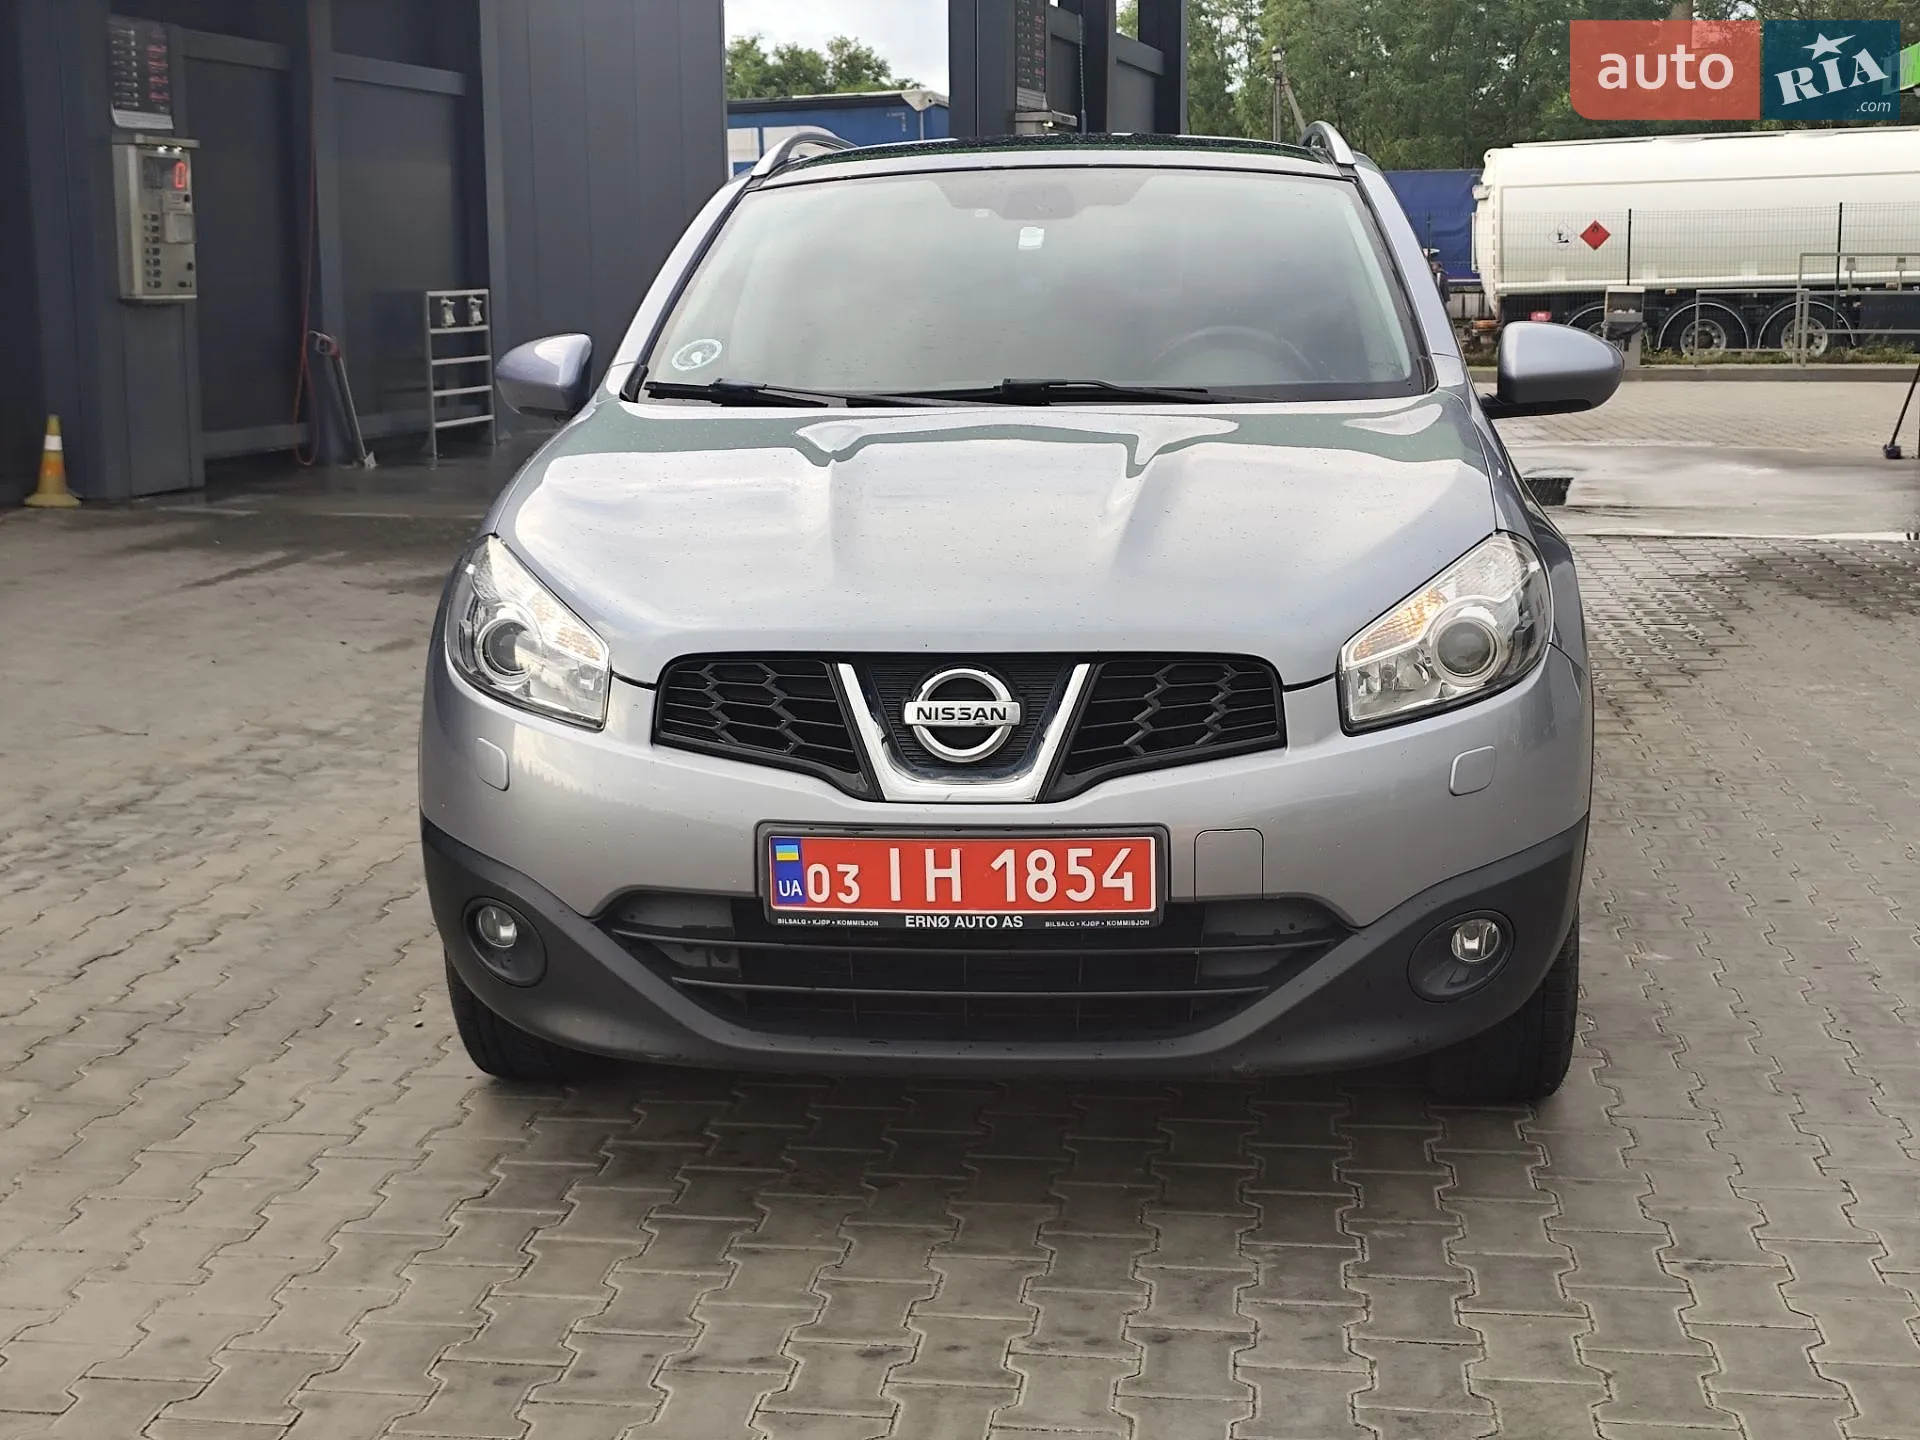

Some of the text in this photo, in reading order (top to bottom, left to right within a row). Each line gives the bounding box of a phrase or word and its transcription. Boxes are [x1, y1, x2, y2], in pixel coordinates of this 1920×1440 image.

[916, 706, 1007, 721] NISSAN
[806, 863, 860, 904] 03
[990, 847, 1134, 903] 1854
[778, 879, 803, 897] UA
[904, 915, 1024, 928] ERNØ AUTO AS
